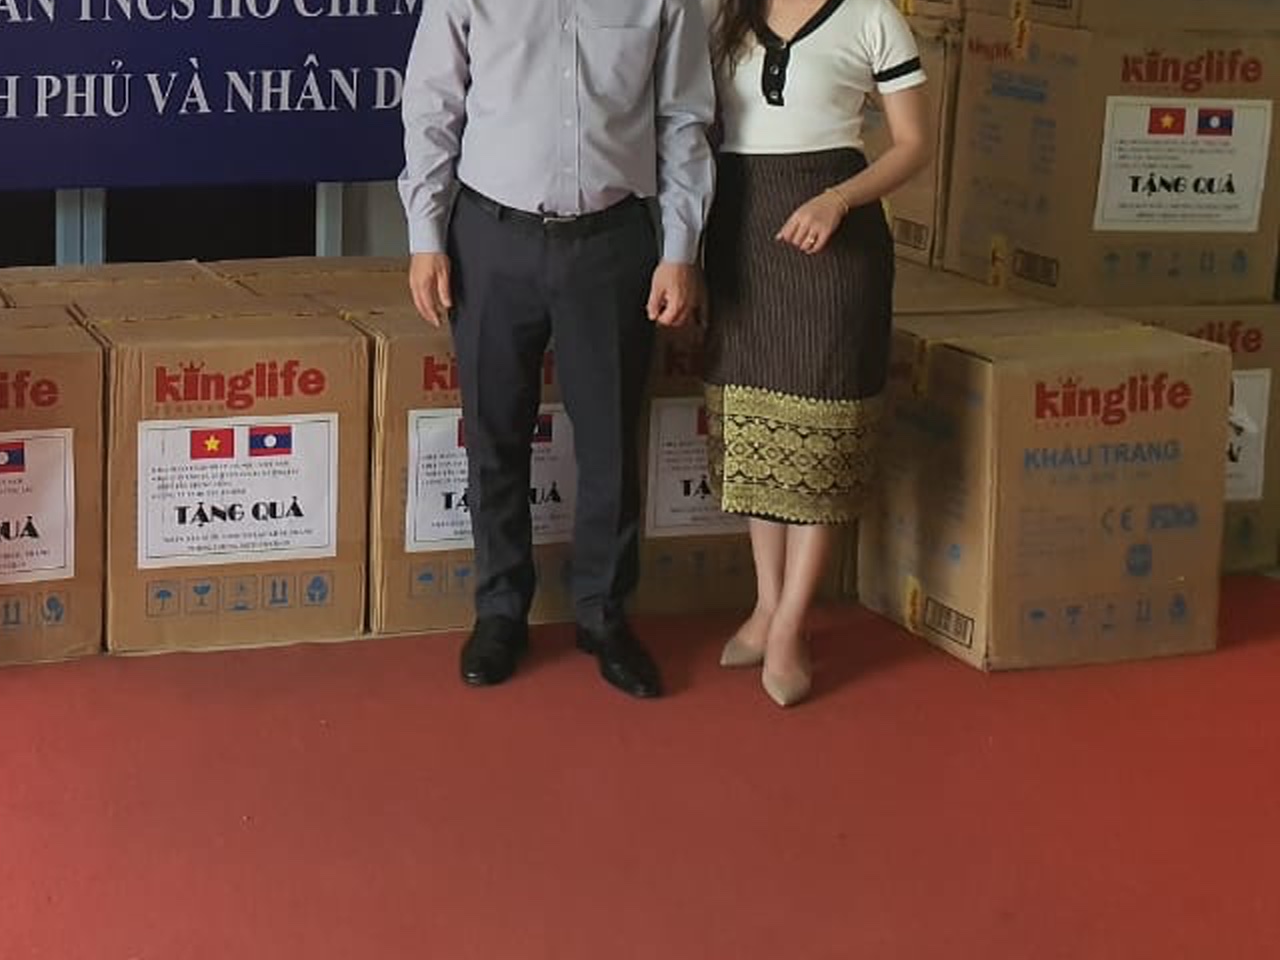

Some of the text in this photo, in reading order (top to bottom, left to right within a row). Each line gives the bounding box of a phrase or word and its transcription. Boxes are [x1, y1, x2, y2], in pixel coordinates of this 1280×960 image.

[34, 59, 132, 117] PHỦ
[146, 57, 213, 115] VÀ
[223, 53, 360, 114] NHÂN
[1120, 47, 1263, 93] kinglife
[155, 359, 326, 410] kinglife
[1035, 372, 1193, 426] kinglife
[174, 501, 246, 528] TẶNG
